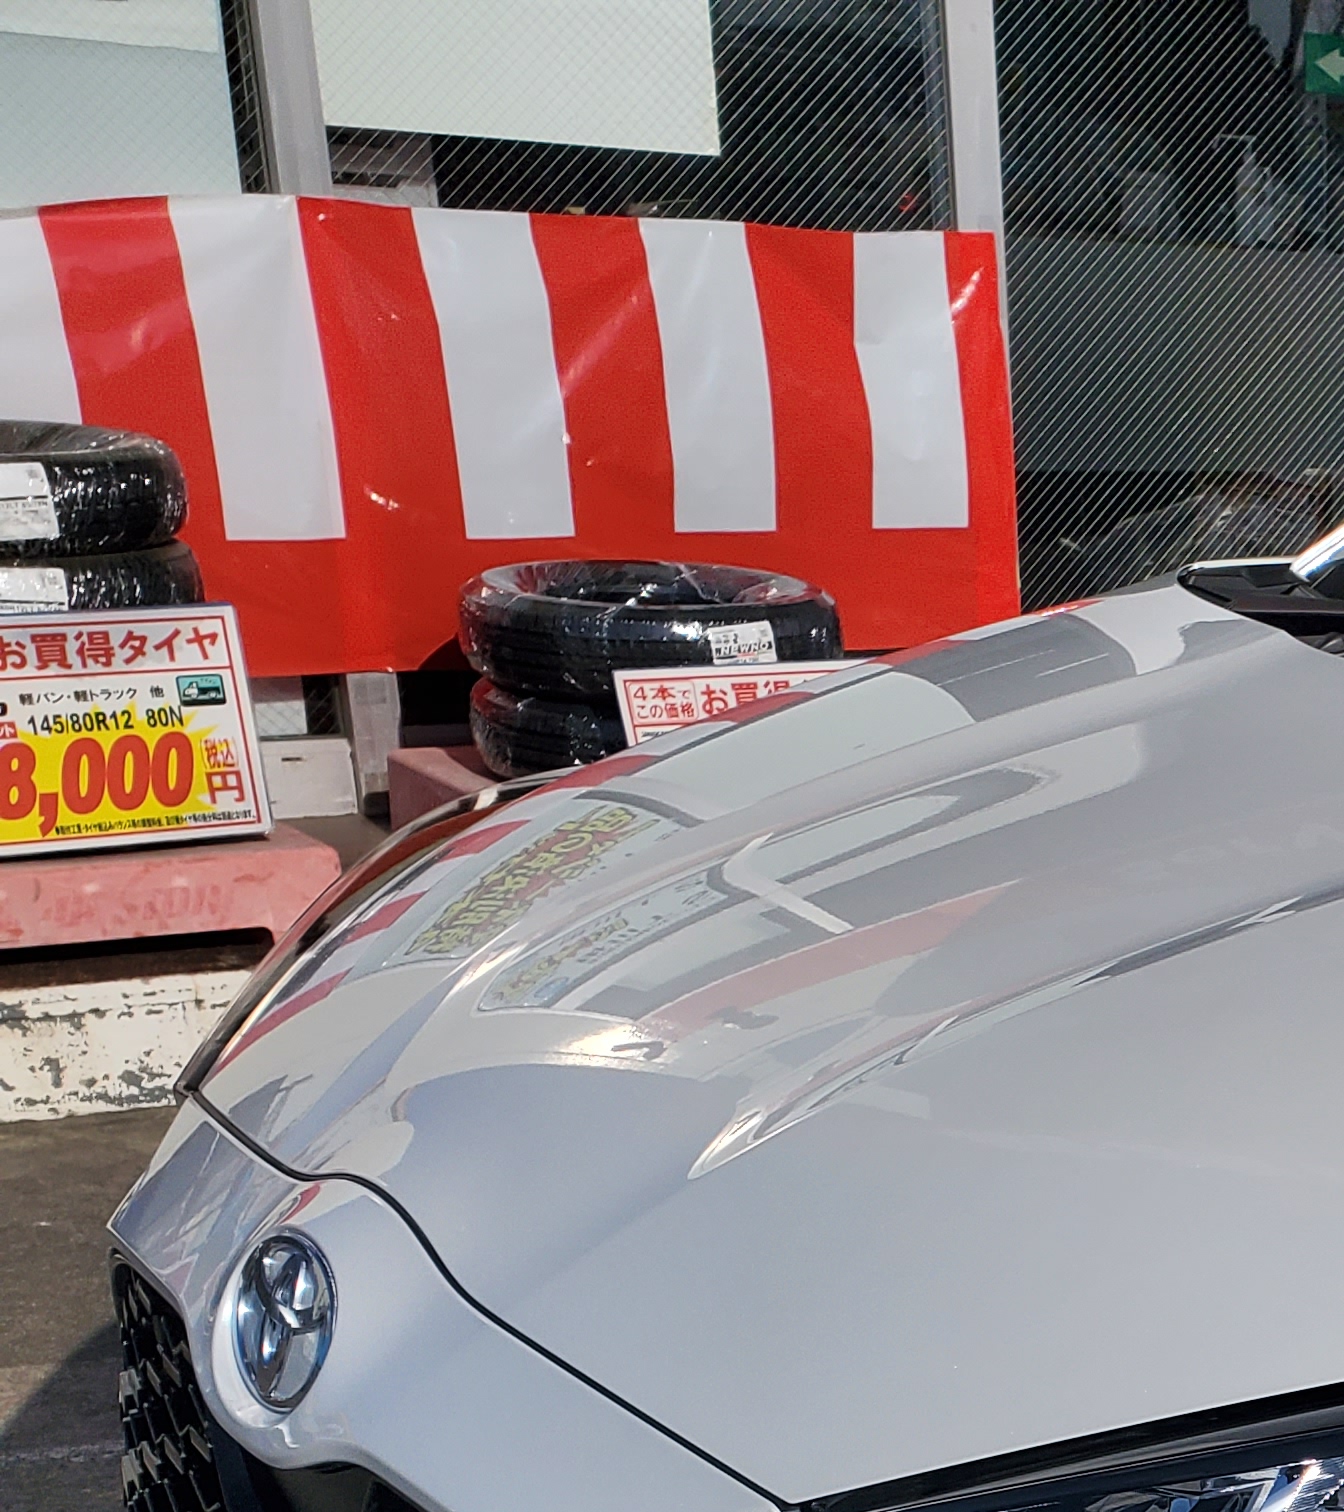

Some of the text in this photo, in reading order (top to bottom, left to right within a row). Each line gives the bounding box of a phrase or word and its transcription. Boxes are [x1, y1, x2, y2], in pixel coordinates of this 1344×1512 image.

[149, 684, 165, 699] 他
[633, 684, 691, 701] 4本で
[636, 702, 695, 719] この価格
[27, 709, 134, 736] 145/80R12
[146, 704, 184, 729] 80N
[205, 769, 246, 804] 円
